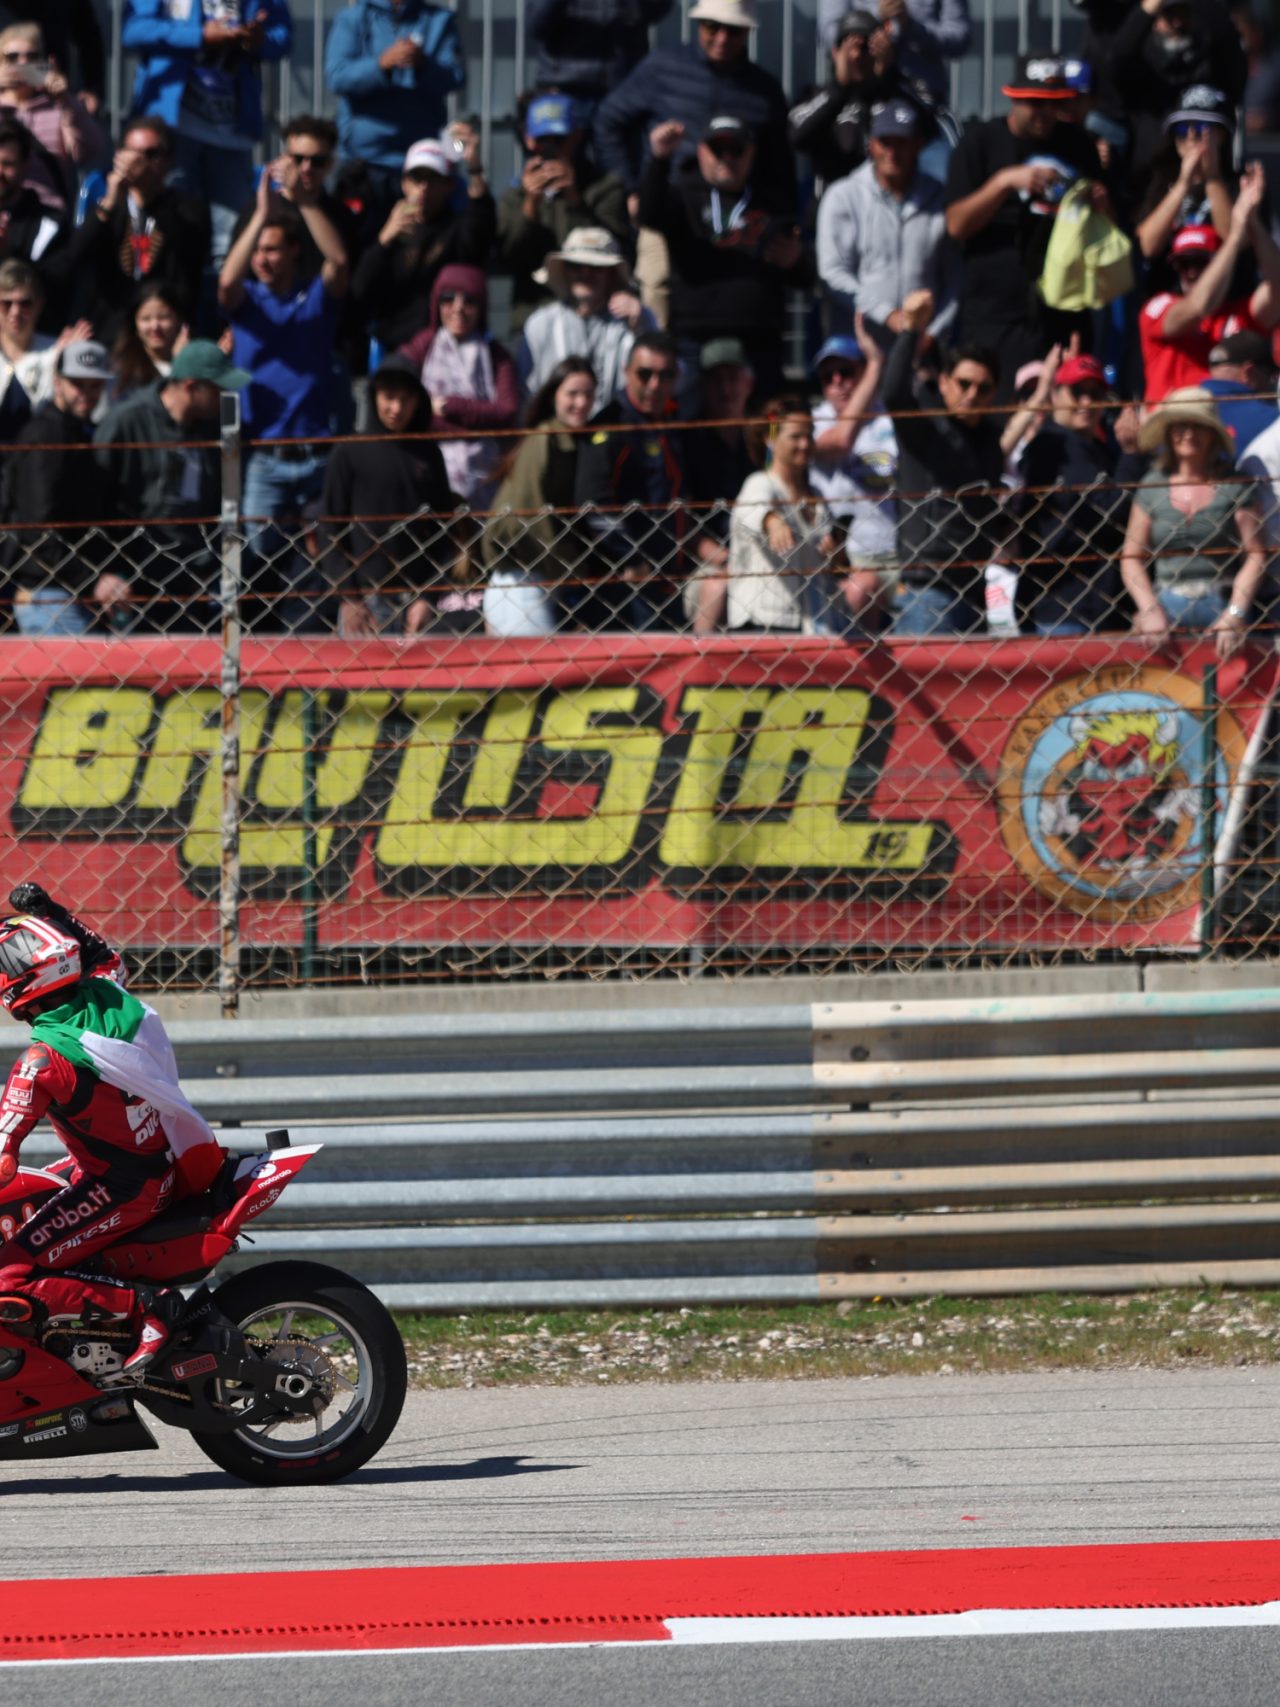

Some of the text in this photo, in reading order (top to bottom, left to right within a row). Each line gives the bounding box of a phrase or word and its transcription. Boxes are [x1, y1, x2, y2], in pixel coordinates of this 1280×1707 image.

[13, 684, 958, 898] BAUTISTA
[862, 829, 908, 863] 19
[135, 1110, 160, 1146] DUC
[258, 1169, 292, 1189] motorola
[29, 1183, 113, 1247] aruba.it
[23, 1426, 68, 1443] PIRELLI
